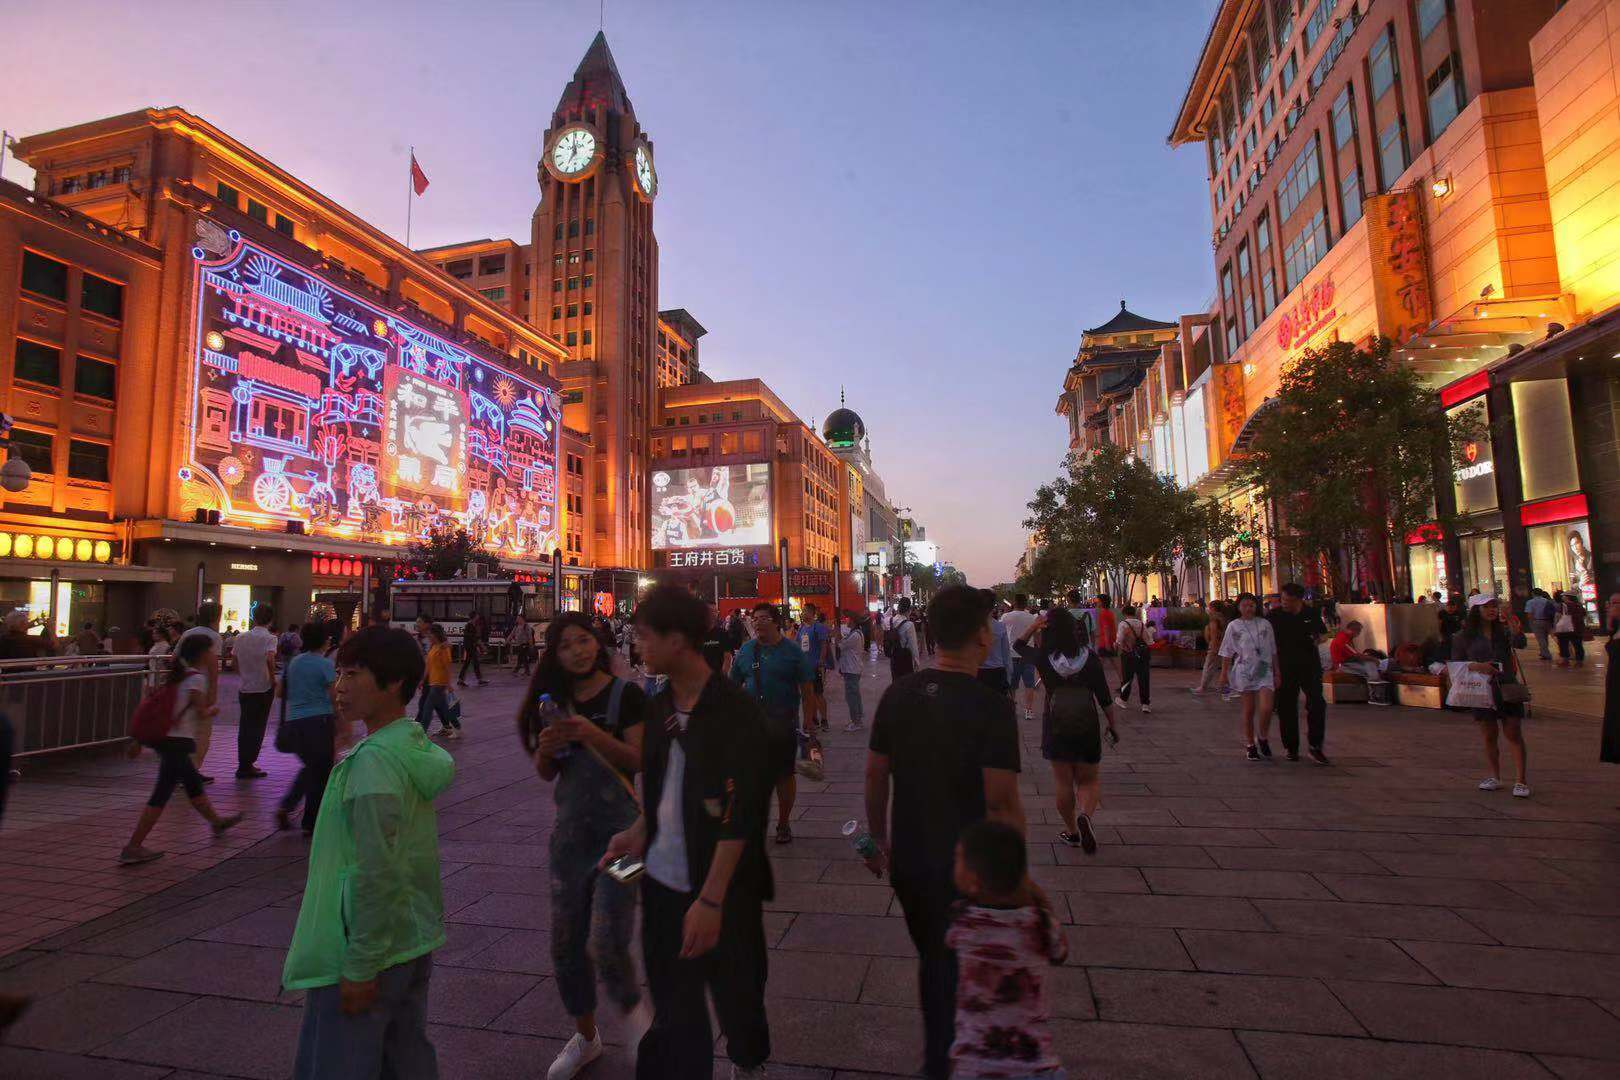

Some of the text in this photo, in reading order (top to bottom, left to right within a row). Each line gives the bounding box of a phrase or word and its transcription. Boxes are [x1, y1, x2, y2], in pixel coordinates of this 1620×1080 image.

[1453, 460, 1494, 481] TUDOR
[669, 548, 745, 567] 王府井百货
